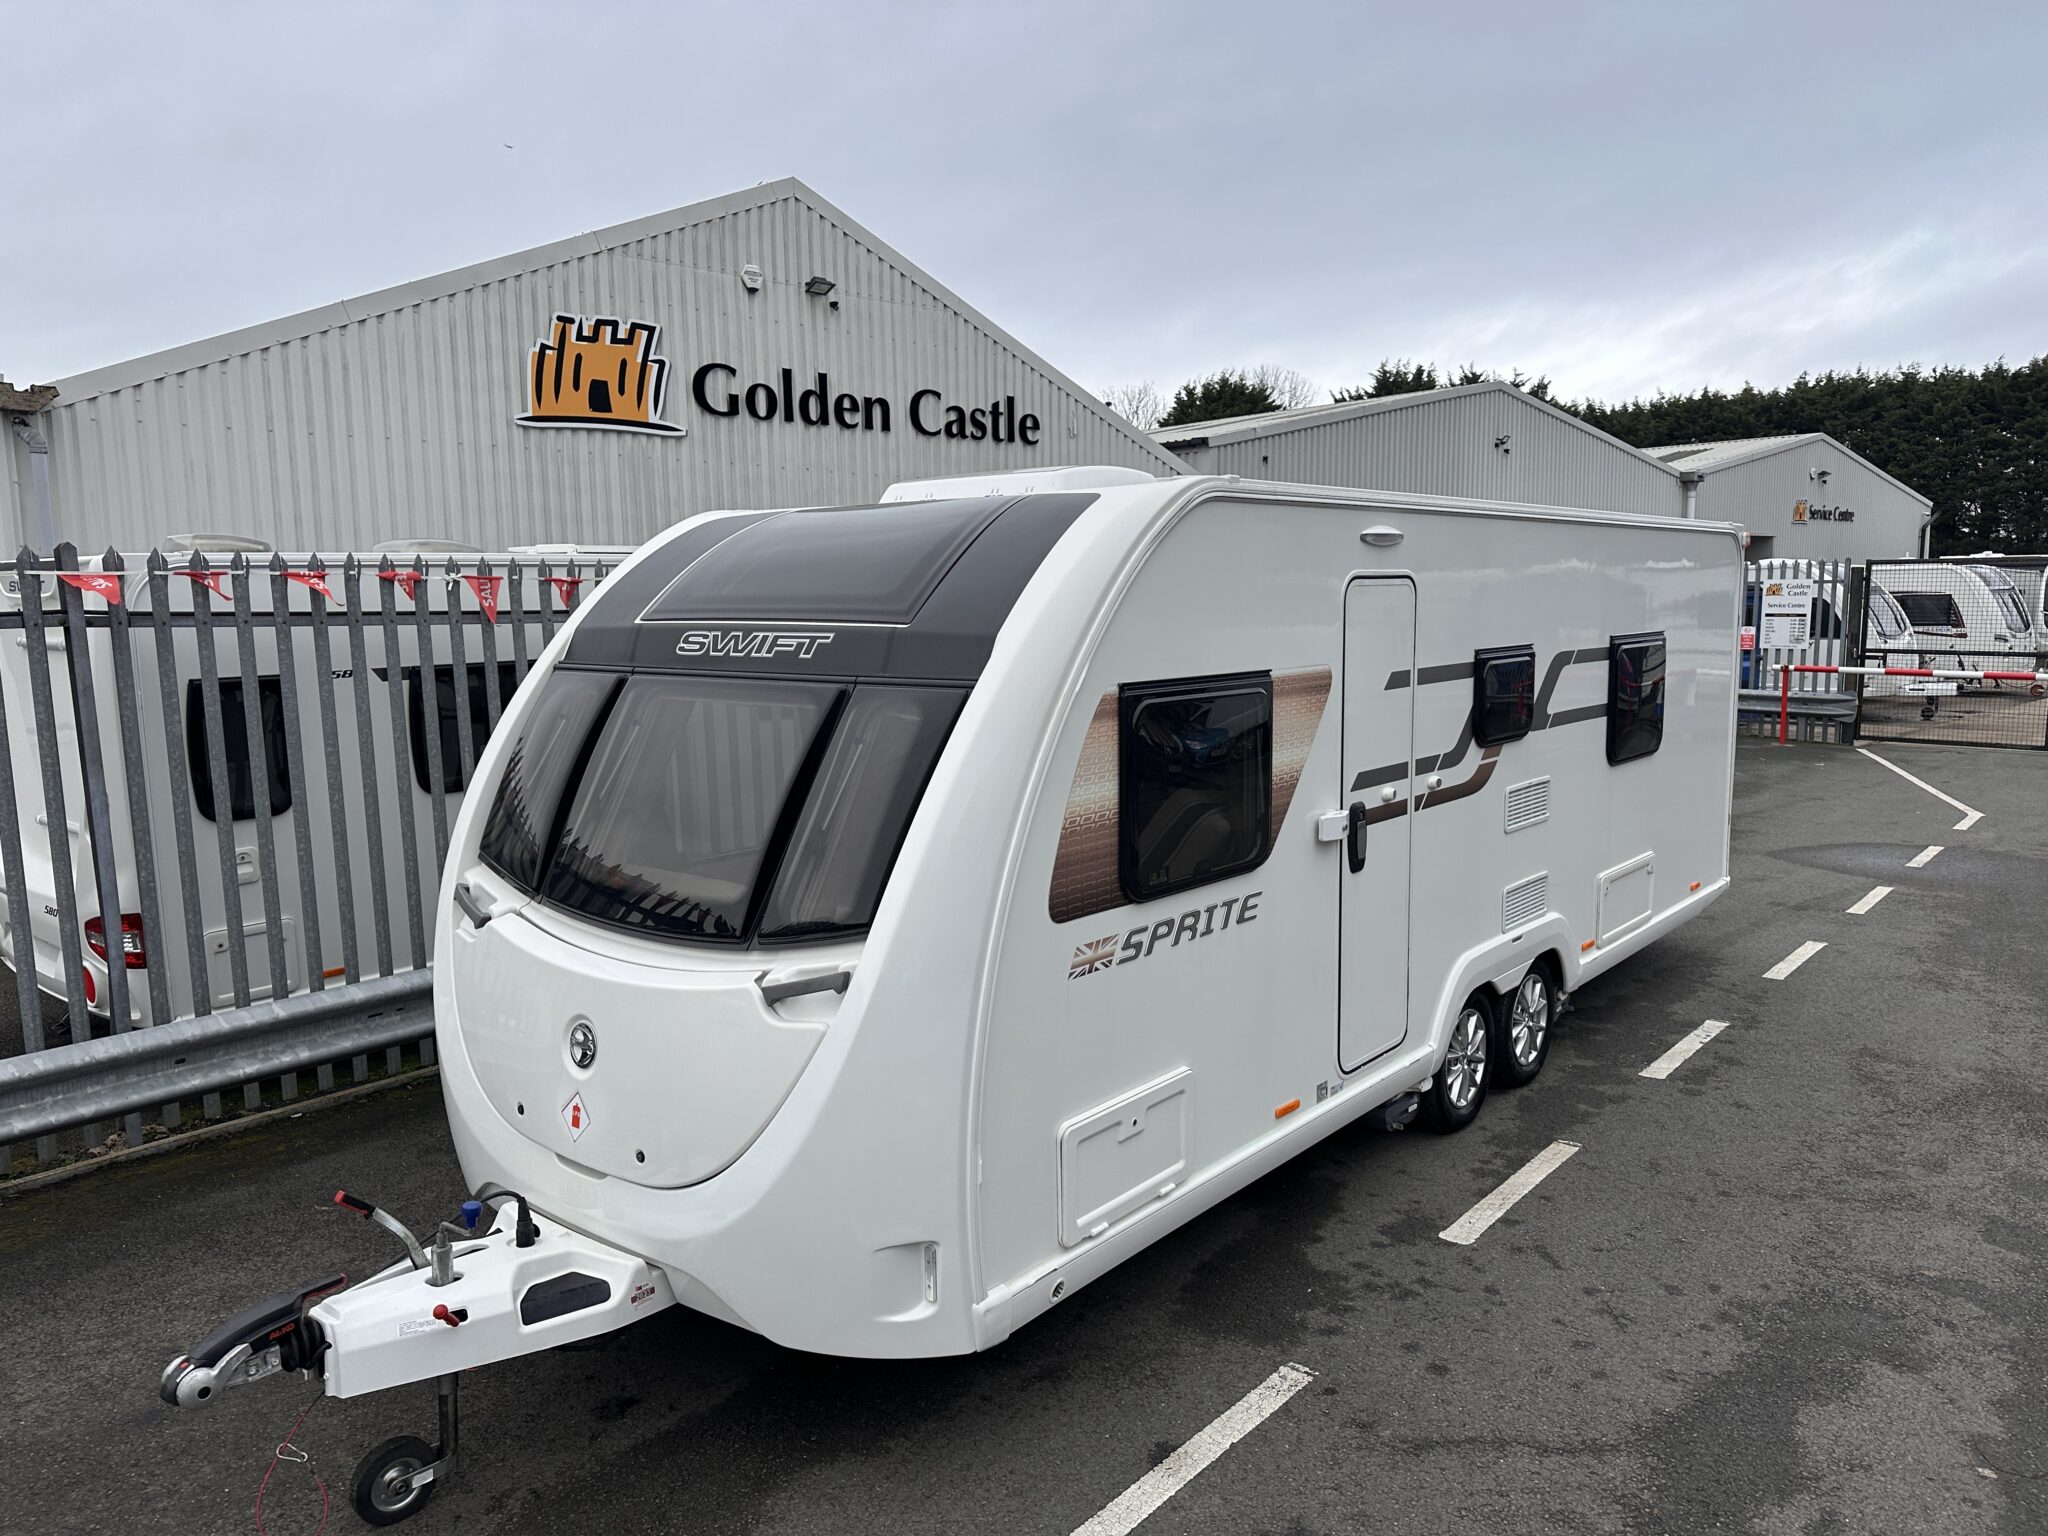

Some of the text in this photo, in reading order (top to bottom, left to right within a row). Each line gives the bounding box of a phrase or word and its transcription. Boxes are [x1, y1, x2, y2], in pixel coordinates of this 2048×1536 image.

[692, 362, 1041, 446] Golden Castle
[1809, 504, 1855, 522] Service Centre
[676, 631, 836, 659] SWIFT
[331, 669, 353, 679] 58
[44, 904, 59, 917] 580
[1116, 891, 1263, 965] SPRITE
